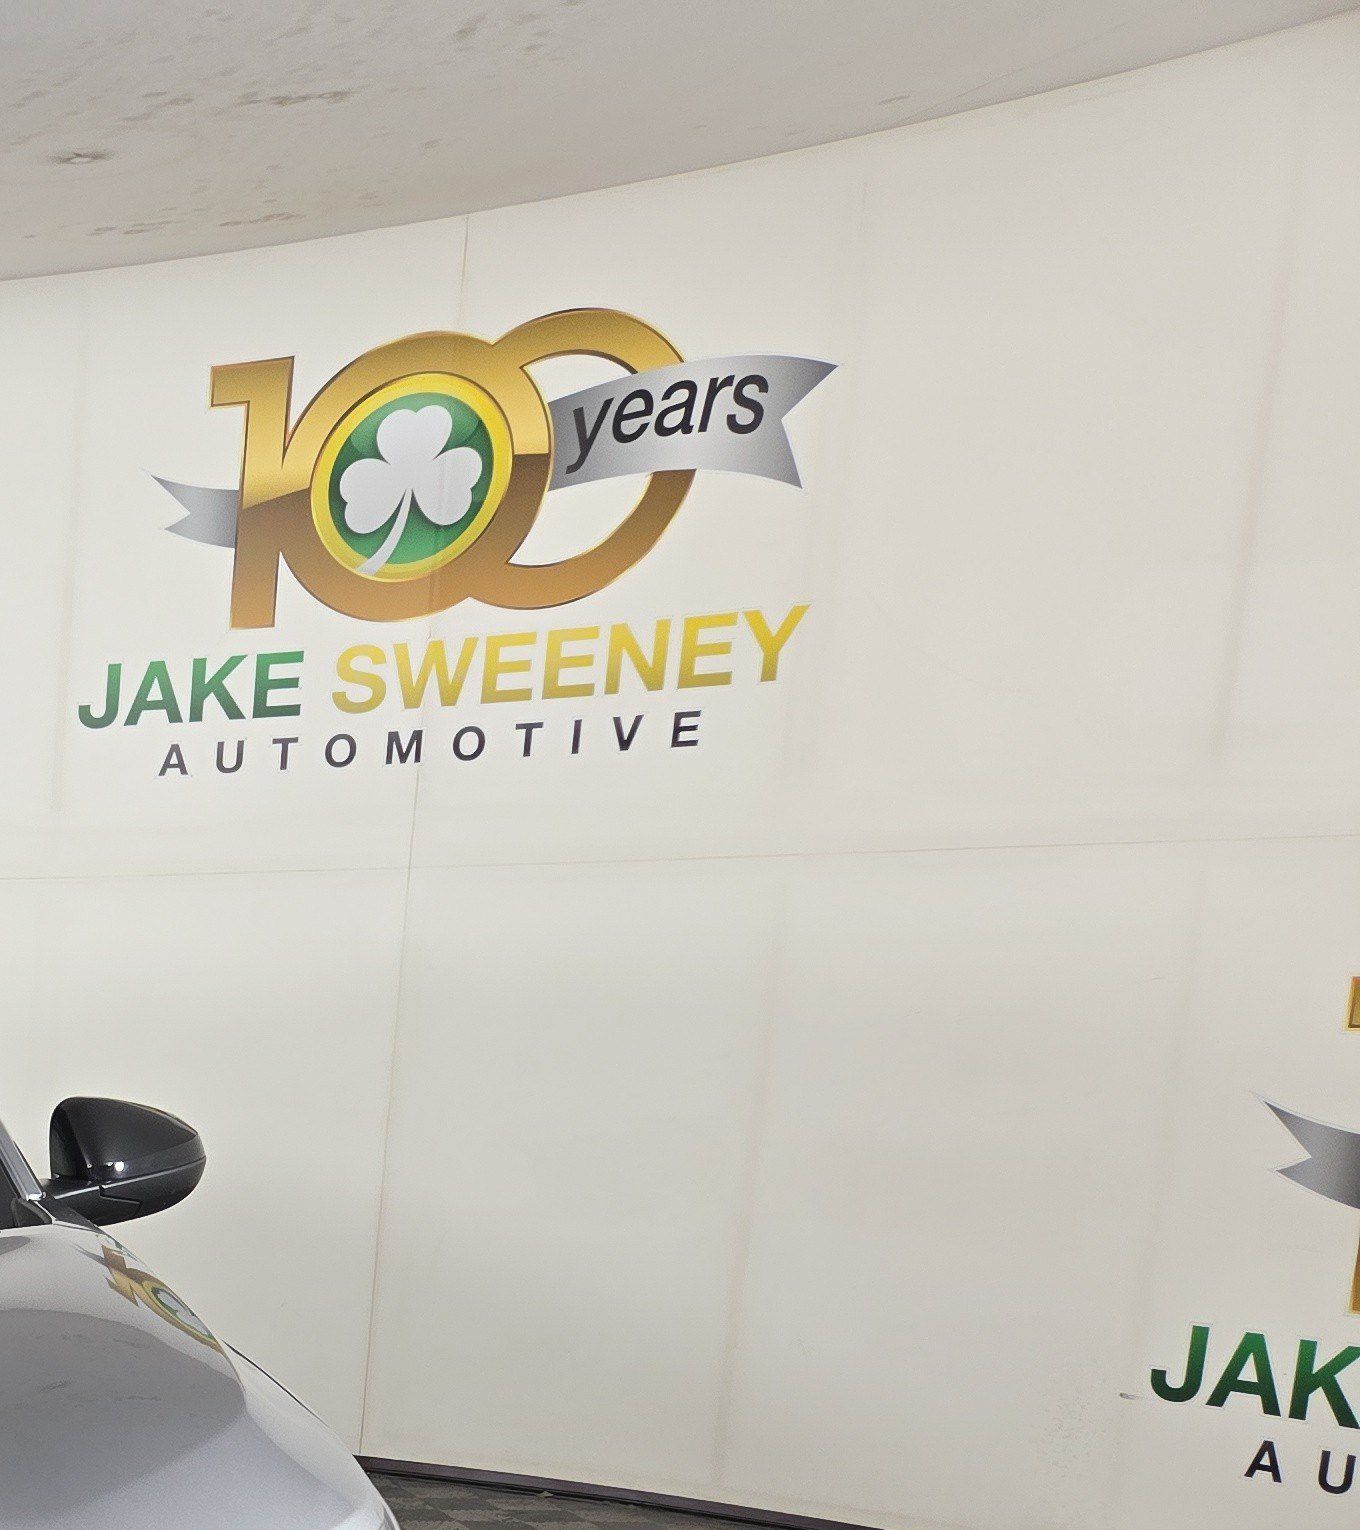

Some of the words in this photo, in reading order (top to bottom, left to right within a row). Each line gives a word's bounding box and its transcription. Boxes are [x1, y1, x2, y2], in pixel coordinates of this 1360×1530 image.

[210, 307, 698, 631] 100
[566, 373, 769, 474] years
[78, 650, 305, 730] JAKE
[331, 604, 811, 714] SWEENEY
[158, 710, 702, 778] AUTOMOTIVE
[1150, 1325, 1360, 1430] JAK
[1244, 1440, 1357, 1495] AU
